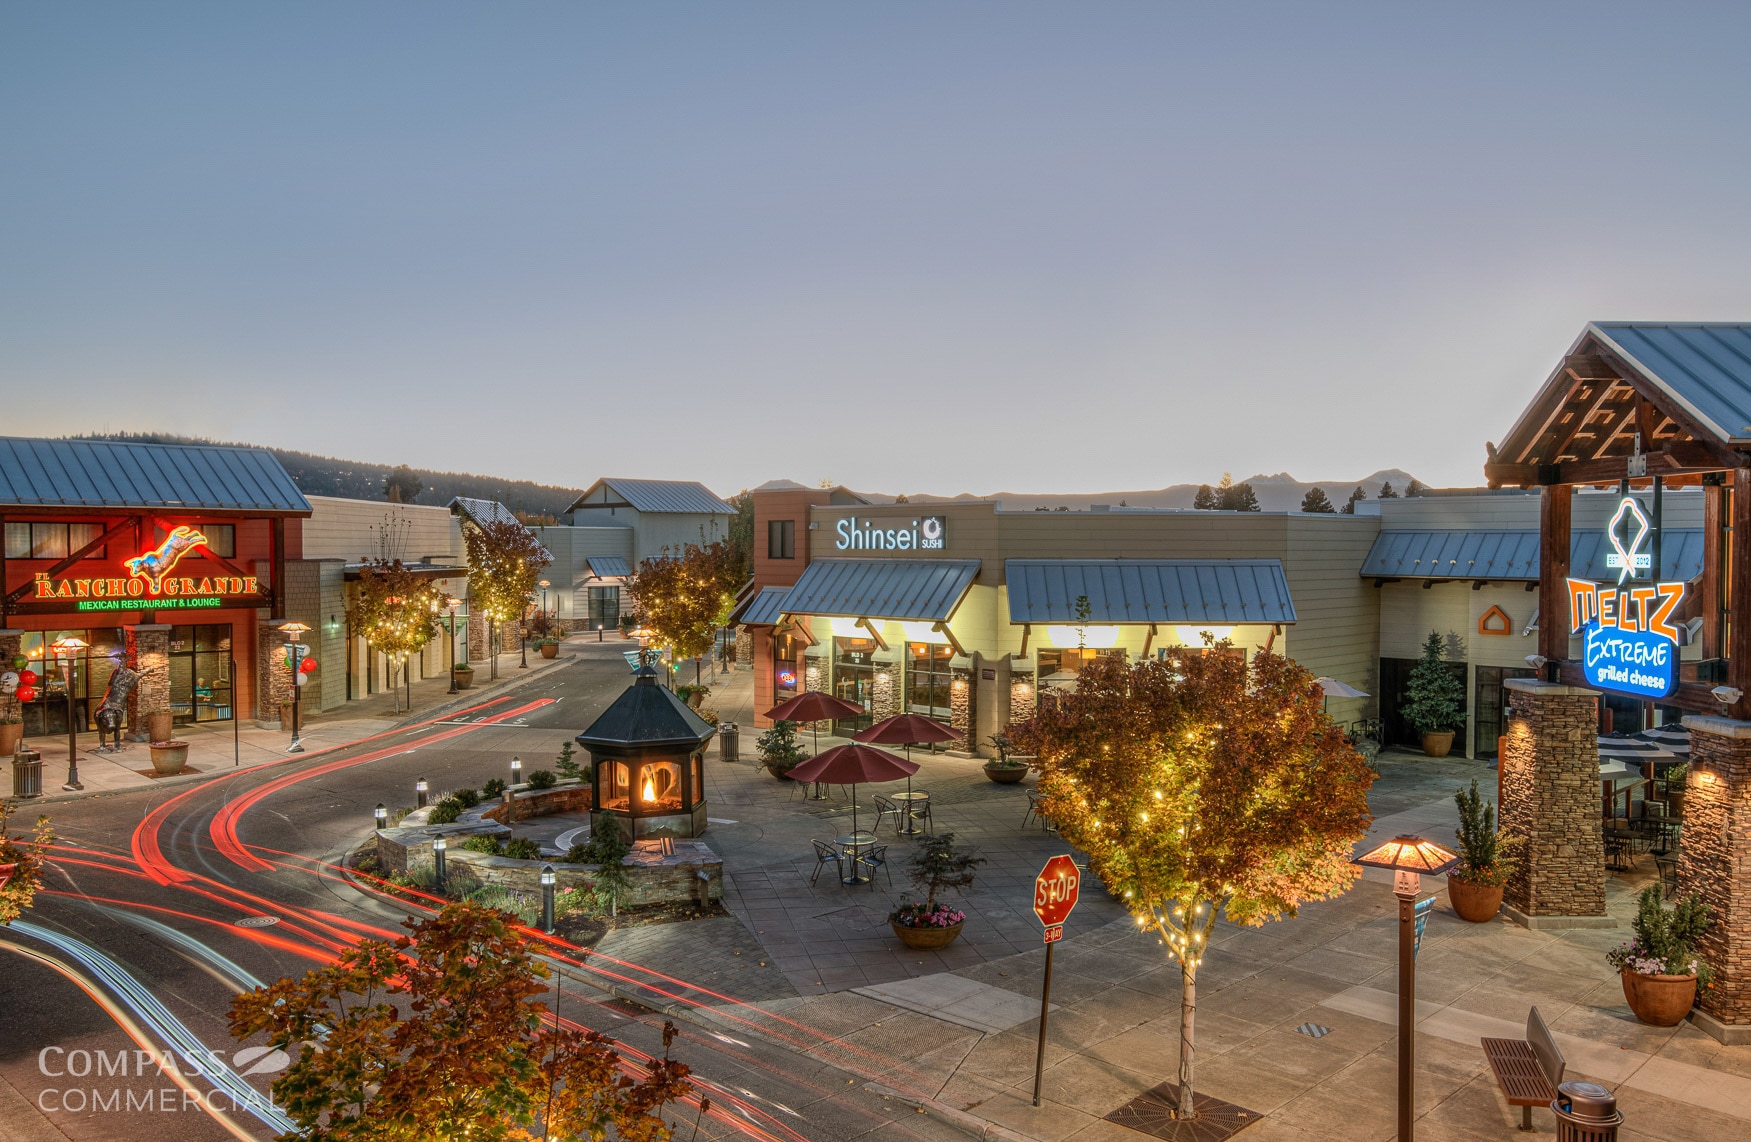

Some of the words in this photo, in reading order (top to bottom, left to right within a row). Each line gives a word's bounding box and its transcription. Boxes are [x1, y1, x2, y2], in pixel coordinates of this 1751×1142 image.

[836, 517, 919, 550] Shinsei
[922, 539, 942, 548] SUSHI
[35, 579, 143, 598] RANCHO
[163, 576, 257, 595] GRANDE
[79, 600, 119, 610] MEXICAN
[121, 599, 177, 609] RESTAURANT
[178, 598, 186, 607] &
[187, 597, 221, 607] LOUNGE
[1566, 577, 1685, 646] MELTZ
[1587, 627, 1669, 668] EXTREME
[1598, 665, 1628, 683] grilled
[1629, 668, 1665, 690] cheese
[1037, 875, 1077, 906] STOP
